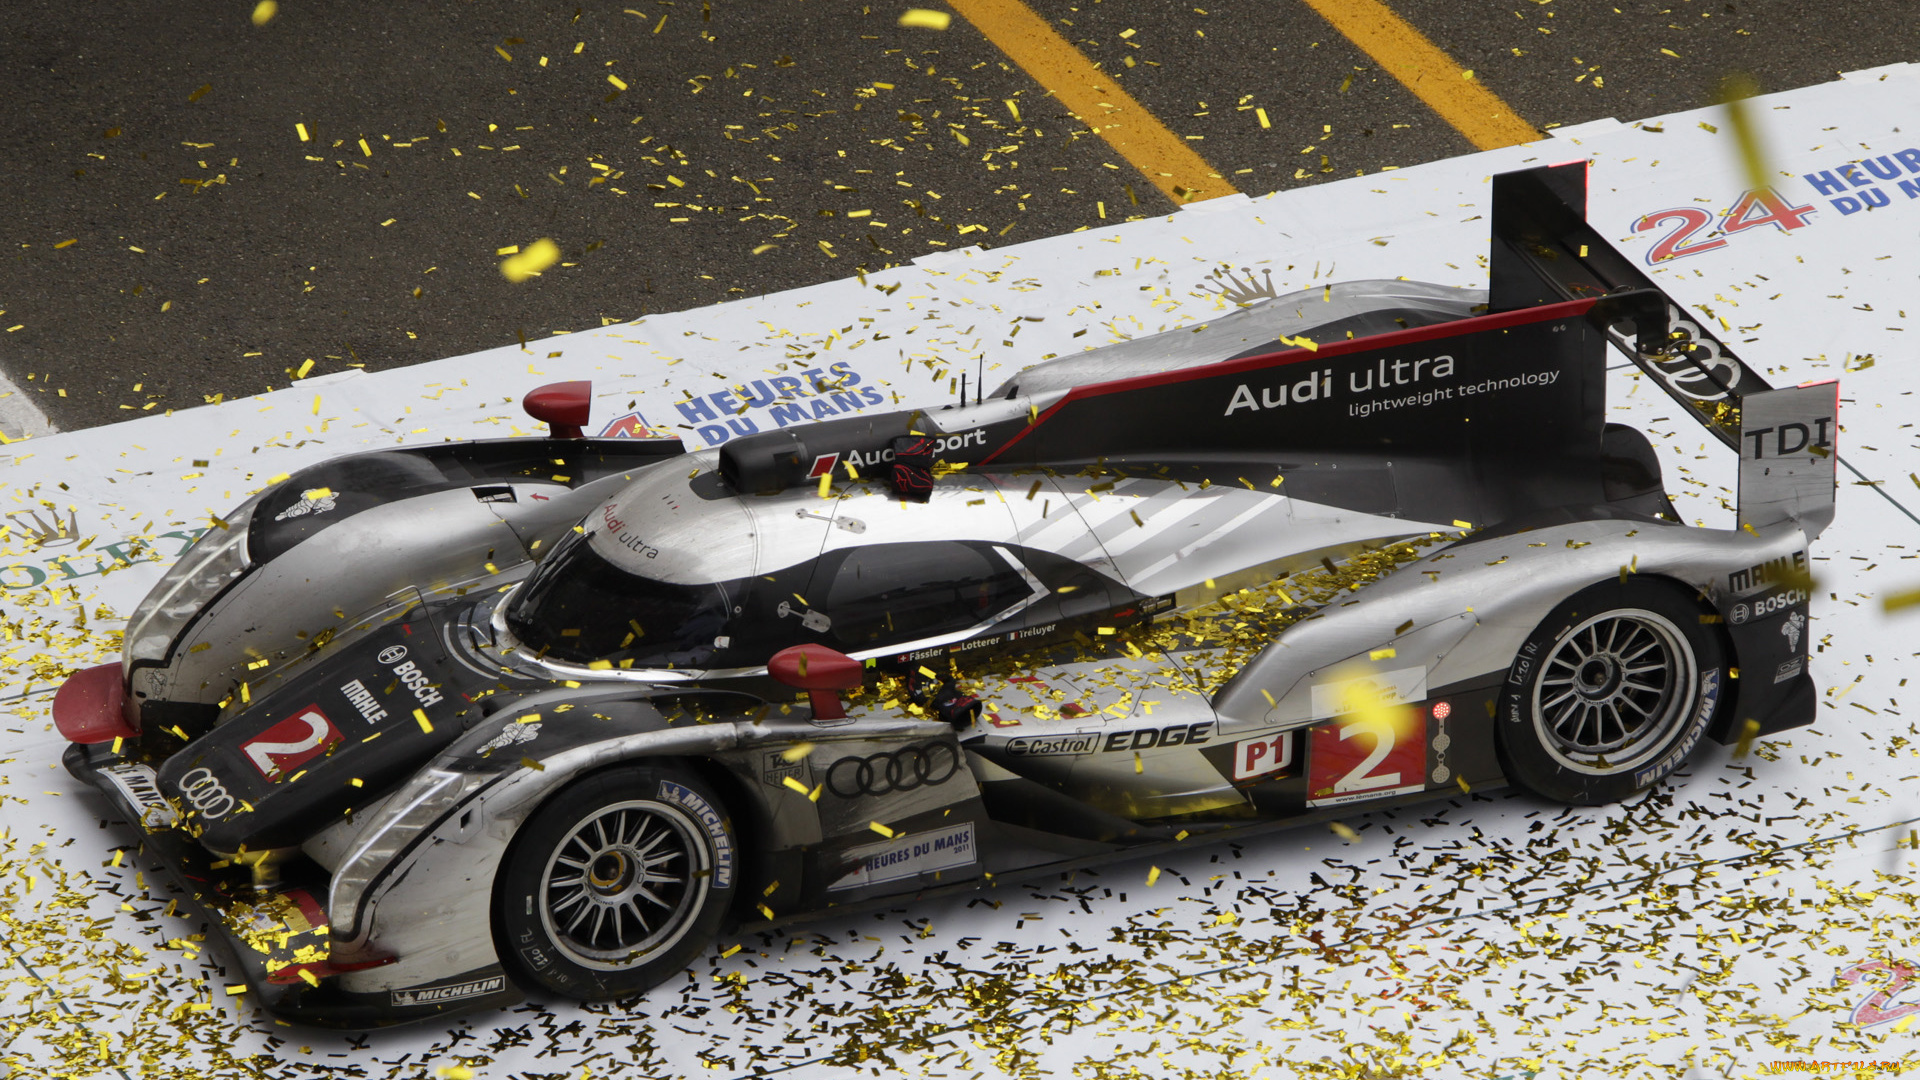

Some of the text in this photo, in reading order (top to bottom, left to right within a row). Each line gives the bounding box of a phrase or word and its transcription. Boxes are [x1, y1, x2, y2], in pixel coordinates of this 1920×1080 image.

[1829, 188, 1891, 216] DU
[1630, 185, 1818, 266] 24
[674, 362, 862, 424] HEURES
[1224, 354, 1455, 417] Audi ultra
[1349, 369, 1561, 418] lightweight technology
[697, 417, 760, 447] DU
[769, 386, 884, 428] MANS
[1744, 416, 1832, 460] TDI
[931, 428, 987, 458] port
[604, 503, 659, 559] Audi ultra
[1754, 588, 1807, 617] BOSCH
[909, 623, 1057, 662] Fässler Lotterer Tréluyer
[340, 679, 389, 725] MAHLE
[392, 660, 444, 708] BOSCH
[244, 711, 329, 778] 2
[1029, 721, 1216, 755] Castrol EDGE
[1246, 734, 1284, 773] P1
[1334, 717, 1401, 794] 2
[1639, 698, 1715, 787] MICHELIN
[122, 775, 167, 808] MANS
[1335, 789, 1397, 803] www.lemans.org
[681, 793, 731, 886] MICHELIN
[865, 845, 910, 872] HEURES
[913, 840, 930, 857] DU
[934, 830, 970, 852] MANS
[953, 843, 970, 855] 2011
[416, 978, 502, 1001] MICHELIN
